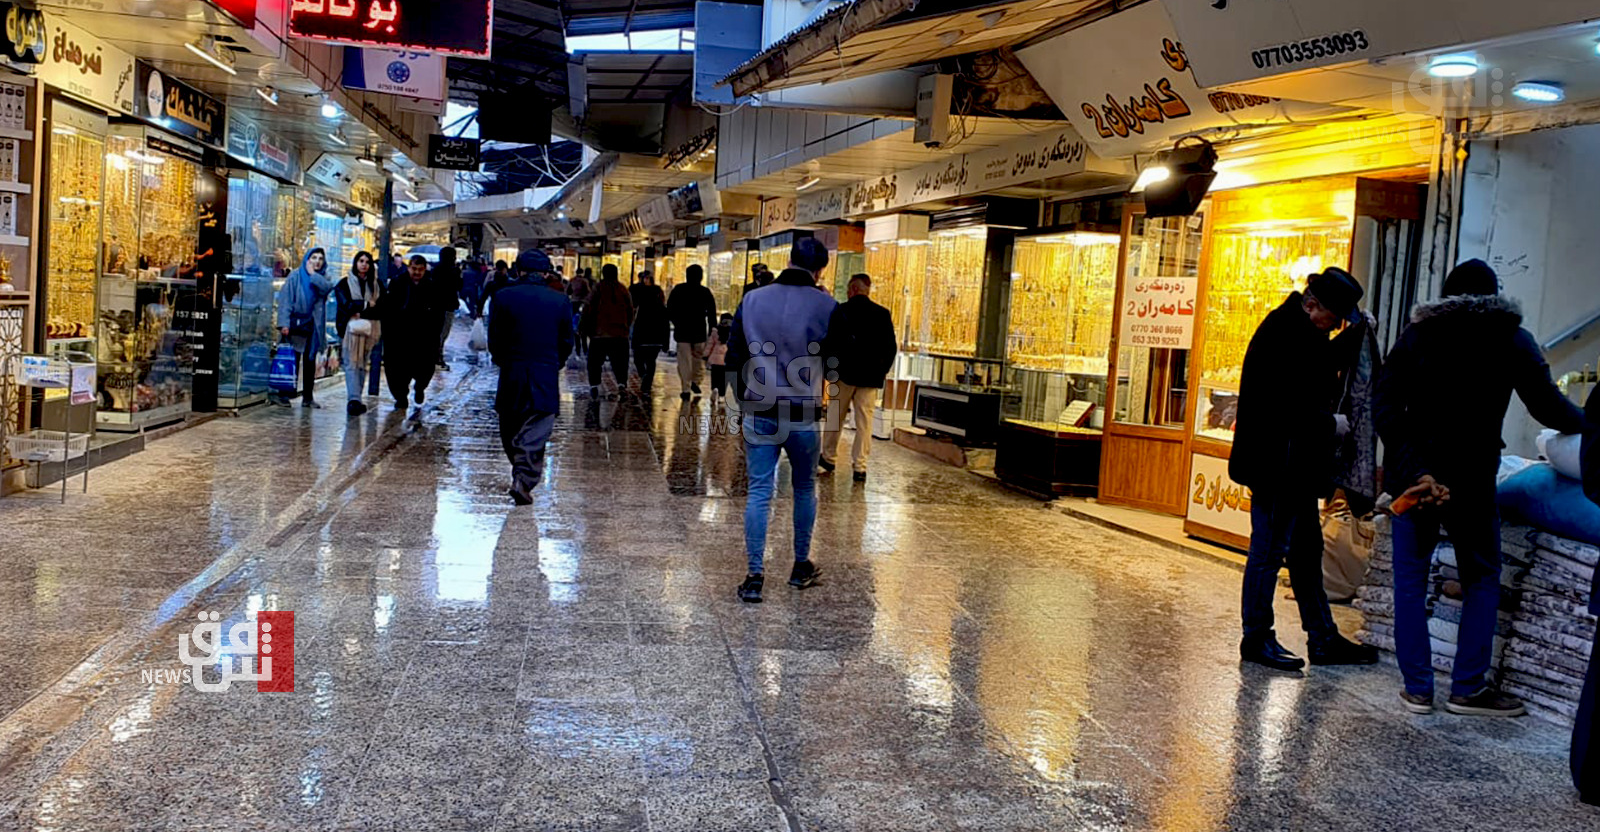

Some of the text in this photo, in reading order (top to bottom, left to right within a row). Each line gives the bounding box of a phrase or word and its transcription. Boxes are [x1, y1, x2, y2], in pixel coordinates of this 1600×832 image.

[1251, 30, 1369, 69] 07703553093
[1081, 102, 1109, 138] 2
[1127, 301, 1136, 316] 2
[1192, 473, 1206, 505] 2
